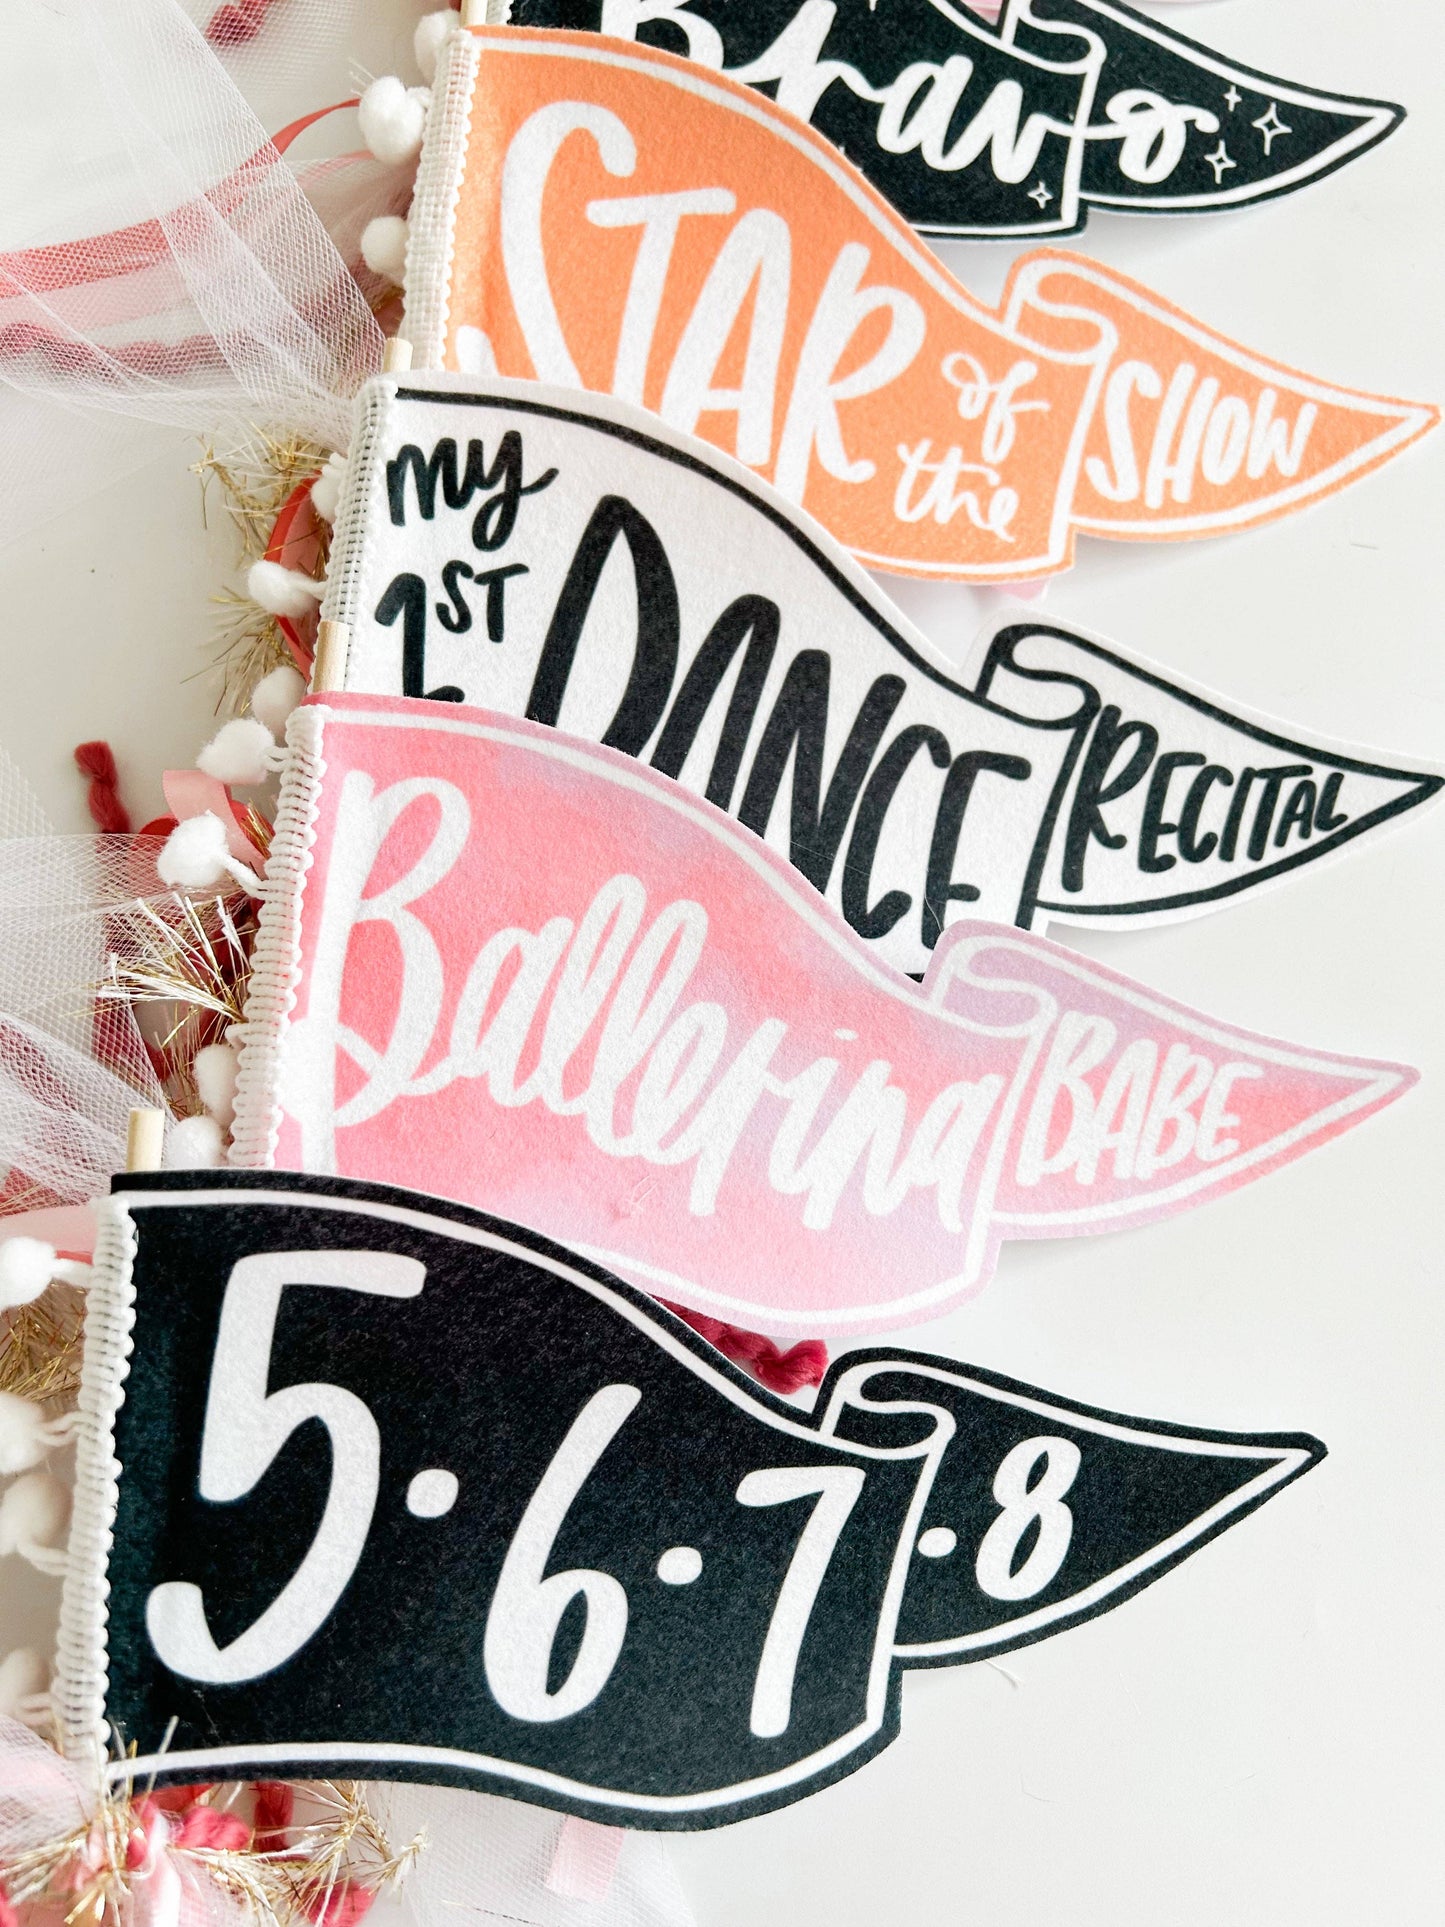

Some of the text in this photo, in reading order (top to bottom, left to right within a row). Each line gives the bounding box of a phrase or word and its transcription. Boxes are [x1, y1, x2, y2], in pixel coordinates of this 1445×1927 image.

[457, 101, 925, 487] STAR
[386, 430, 559, 552] my
[896, 440, 1017, 542] the
[942, 352, 1050, 464] of
[1087, 362, 1317, 509] SHOW
[525, 494, 1032, 948] DANCE
[1062, 705, 1349, 893] RECITAL
[279, 769, 1003, 1234] Ballerina
[1016, 1009, 1266, 1188] BABE
